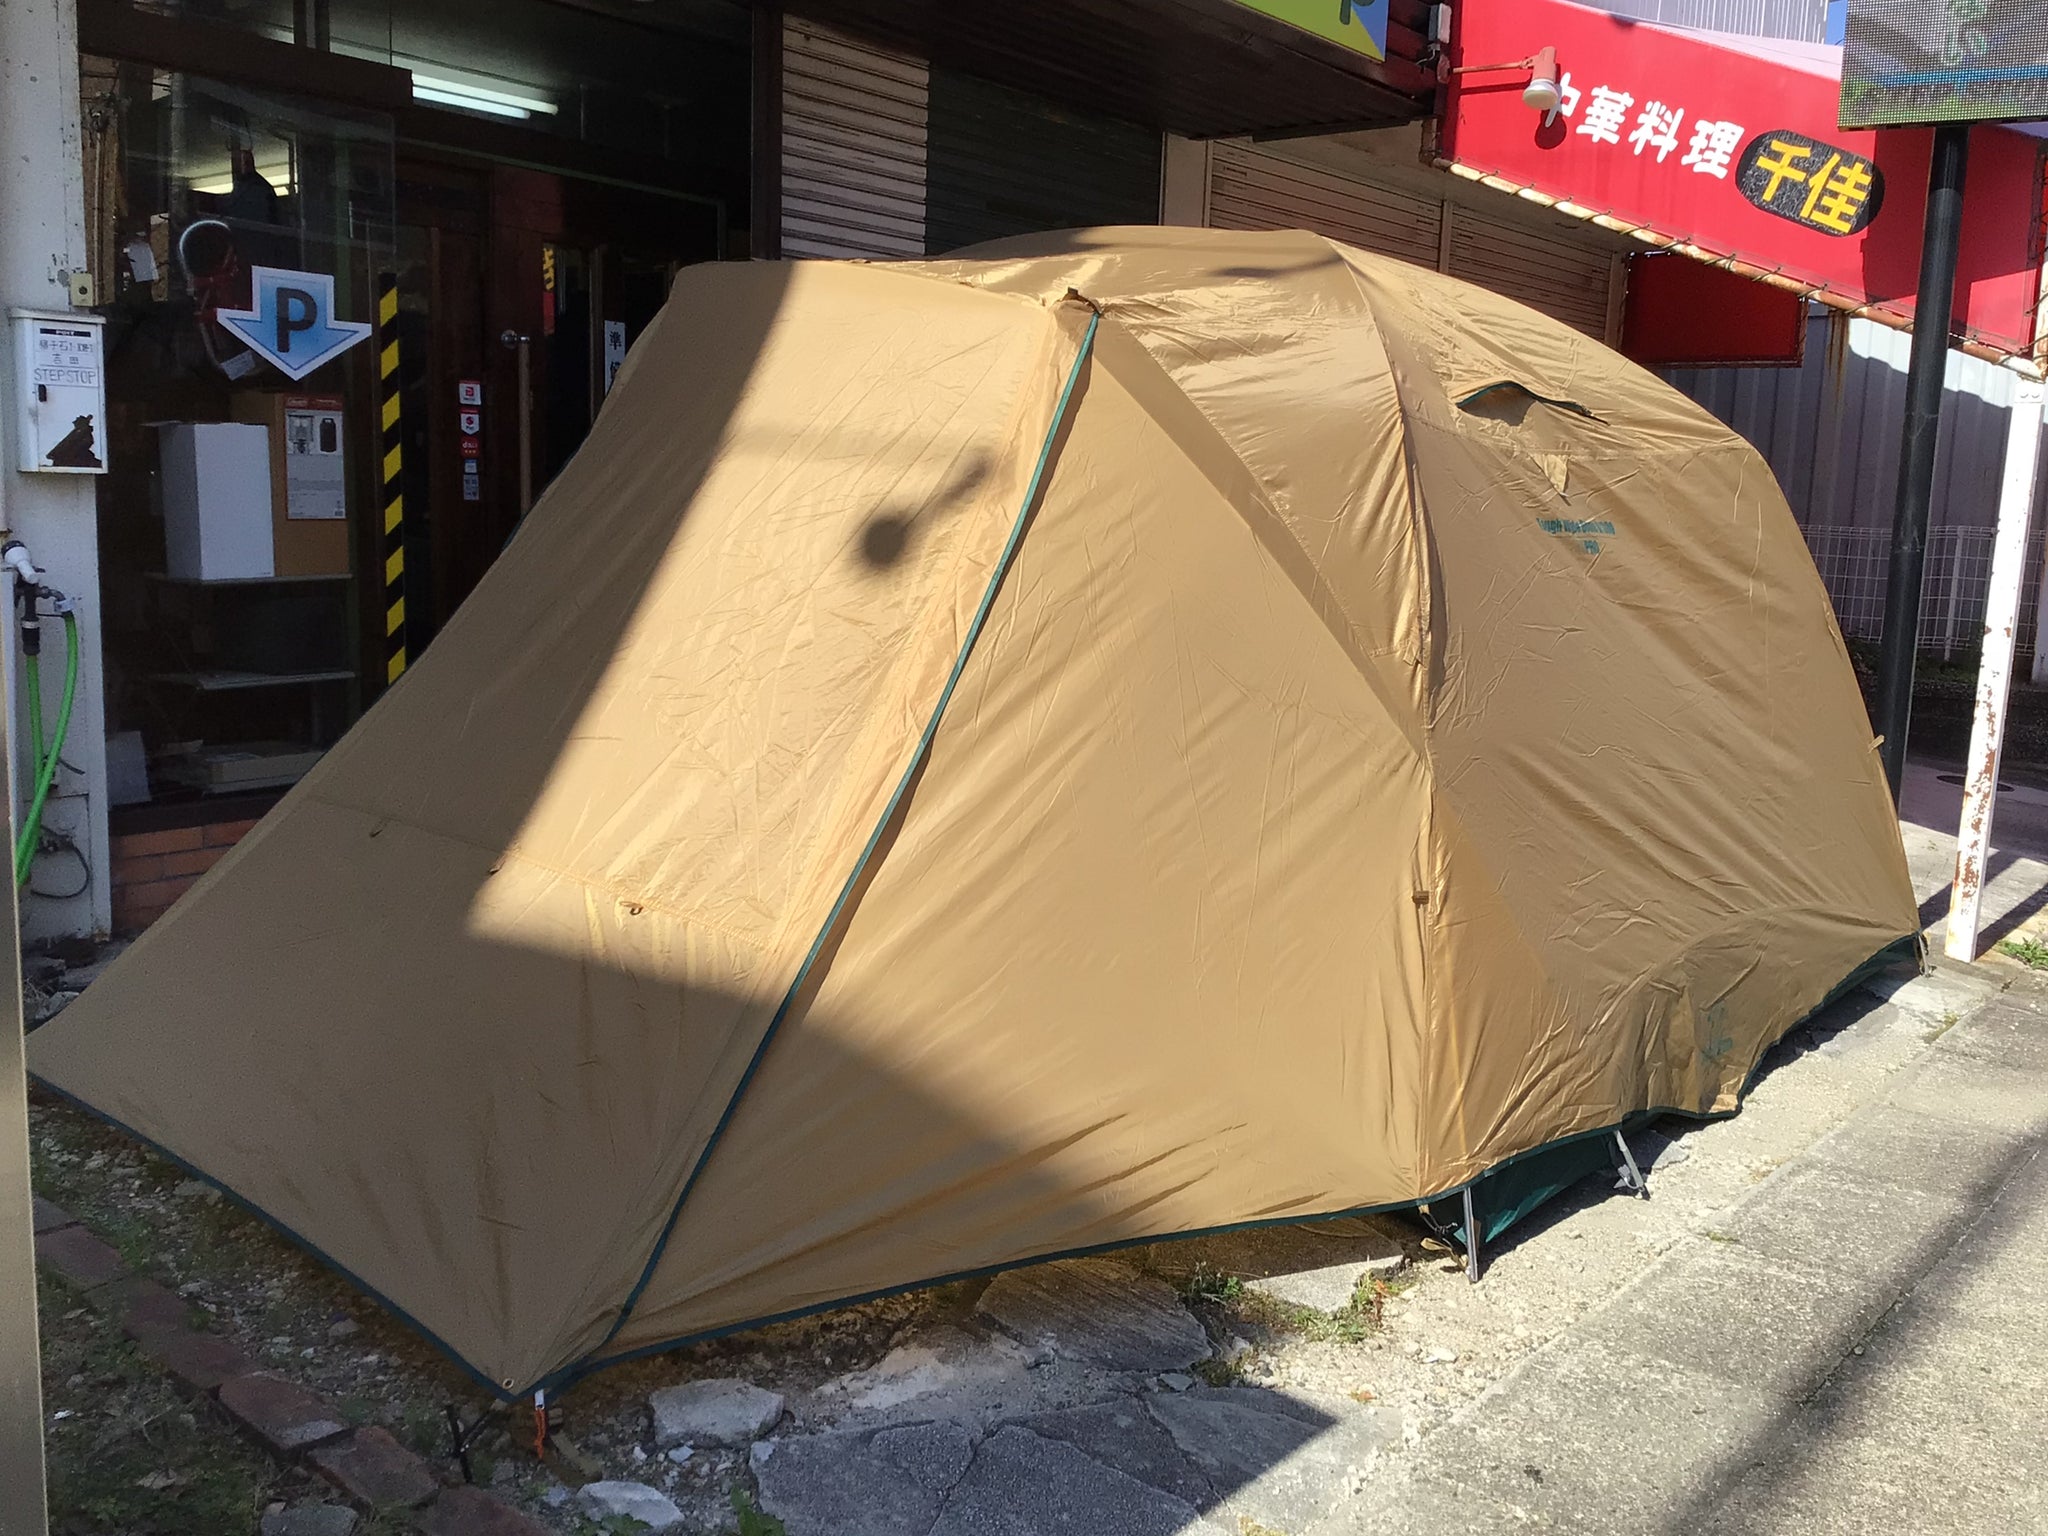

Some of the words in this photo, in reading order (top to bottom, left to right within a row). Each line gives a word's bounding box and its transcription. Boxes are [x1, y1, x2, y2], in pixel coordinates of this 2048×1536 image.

[1546, 72, 1745, 180] 中華料理
[1756, 139, 1875, 234] 千佳
[276, 287, 318, 353] P
